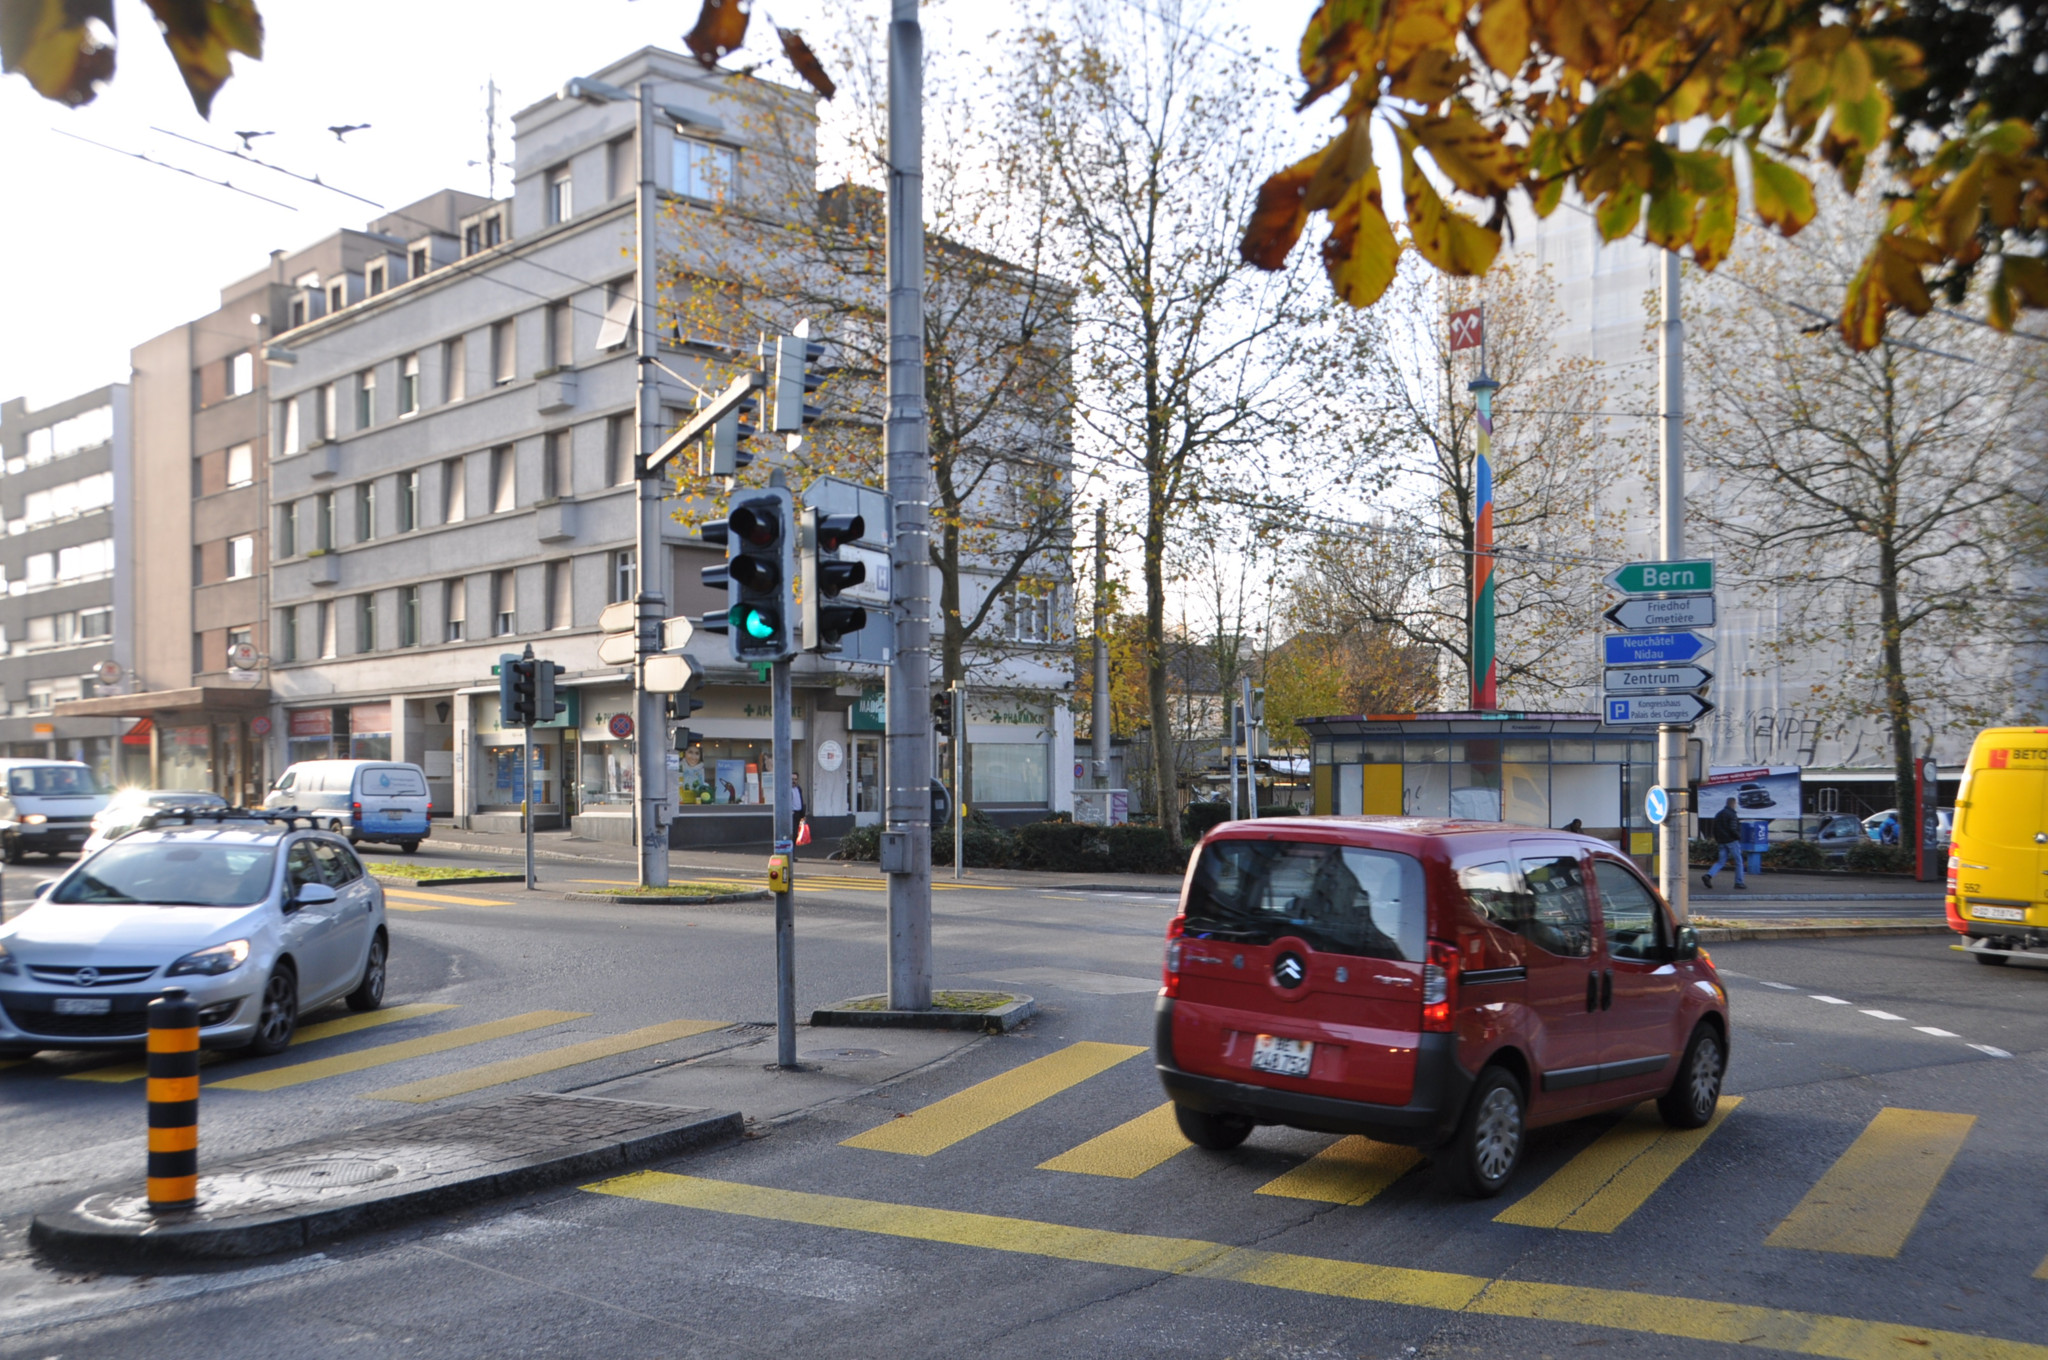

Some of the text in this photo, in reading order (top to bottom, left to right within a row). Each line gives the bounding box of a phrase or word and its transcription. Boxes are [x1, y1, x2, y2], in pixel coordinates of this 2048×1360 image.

[1643, 567, 1695, 587] Bern
[1648, 599, 1690, 612] Friedhof
[1645, 613, 1694, 625] Cimetière
[1623, 635, 1675, 648] Neuchâtel
[1634, 649, 1664, 660] Nidau
[1623, 672, 1680, 685] Zentrum
[1615, 703, 1625, 718] P
[1638, 700, 1681, 709] Kongresshaus
[1631, 711, 1648, 719] Palais
[1663, 710, 1689, 720] Congrès
[1275, 1037, 1291, 1052] BE
